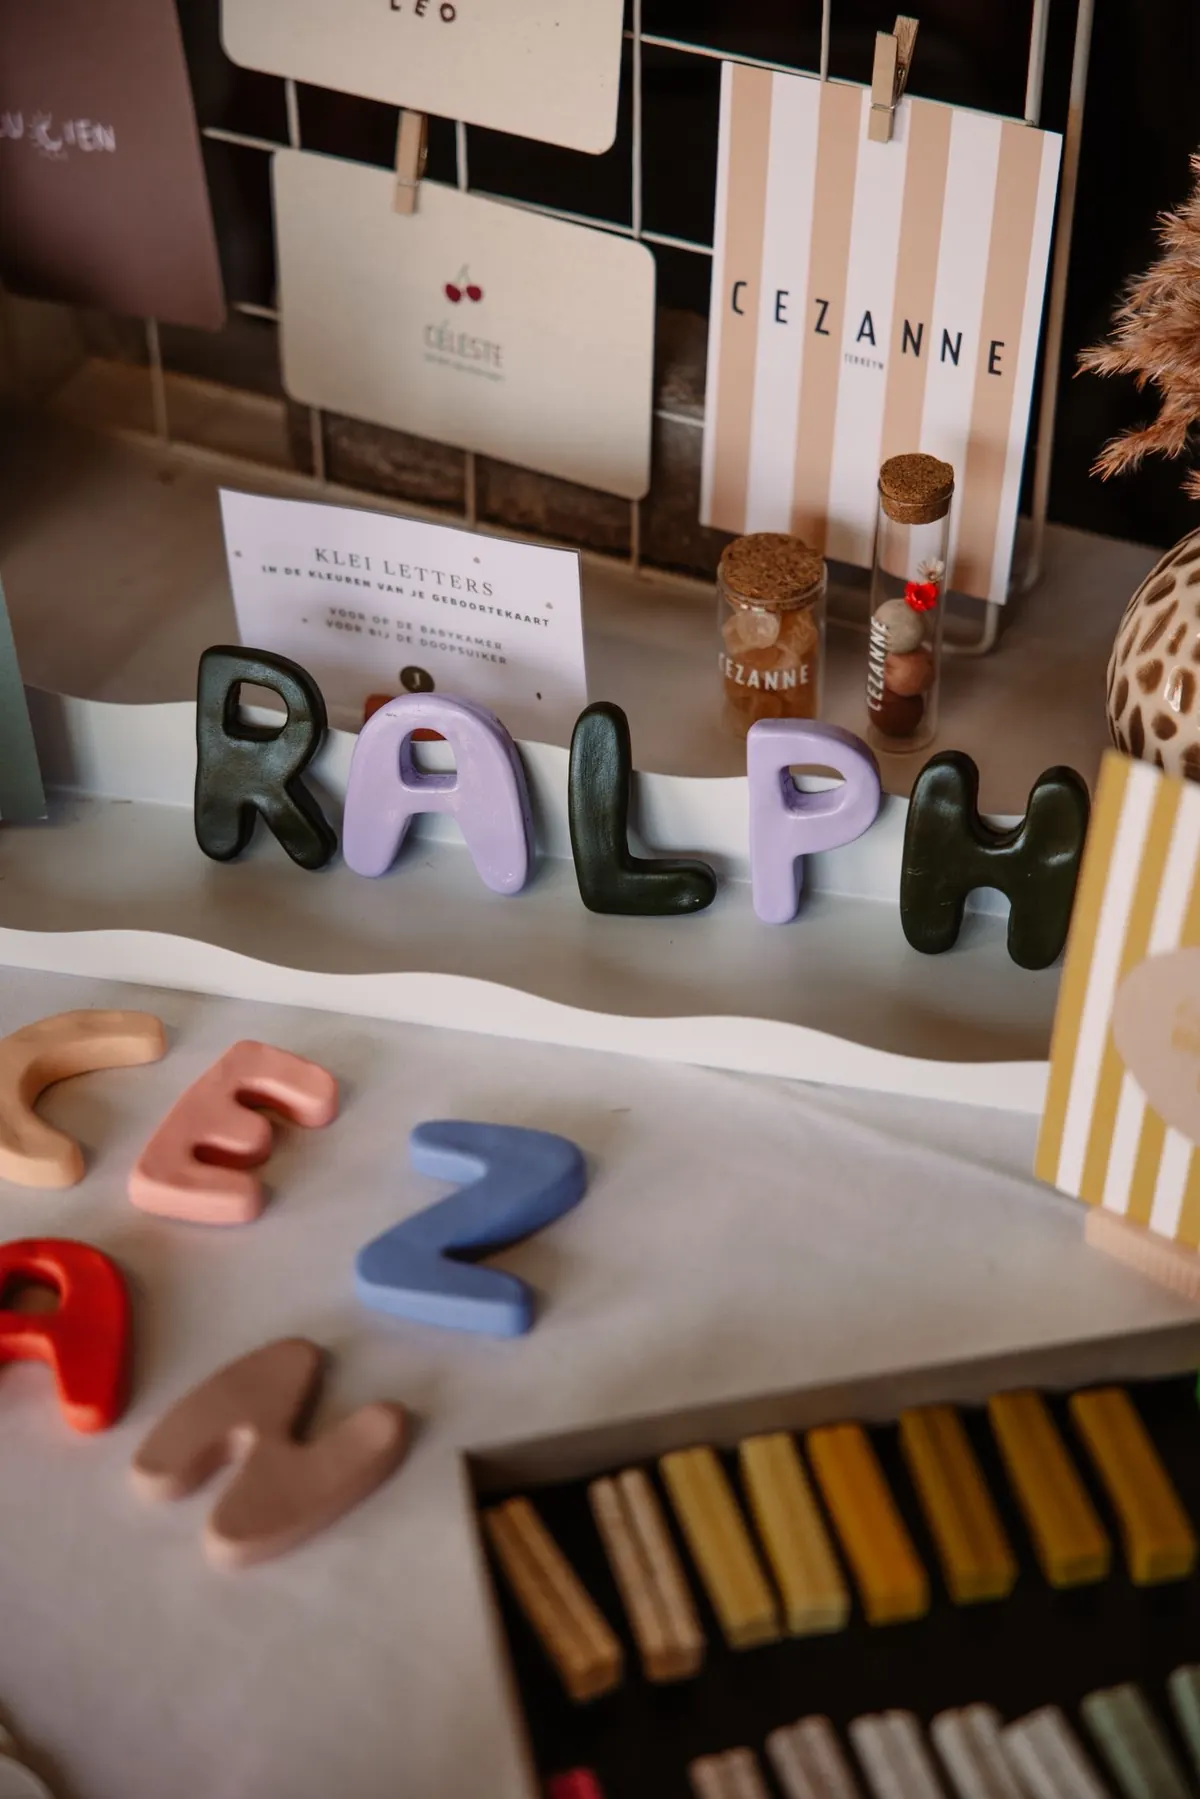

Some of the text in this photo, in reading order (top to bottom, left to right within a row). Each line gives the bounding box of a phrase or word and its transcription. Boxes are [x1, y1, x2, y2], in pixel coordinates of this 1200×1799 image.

[0, 110, 116, 158] UCIEN
[731, 280, 1005, 377] CEZANNE
[284, 567, 301, 576] DE
[308, 570, 371, 588] KLEUREN
[377, 582, 404, 594] VAN
[410, 590, 425, 600] JE
[431, 593, 550, 627] GEBOORTEKAART
[315, 547, 494, 597] KLEI LETTERS
[326, 619, 362, 633] VOOR
[396, 633, 412, 644] DE
[420, 638, 507, 665] DOOPSUIKER
[329, 607, 502, 650] VOOR OP DE BABYKAMER
[718, 651, 809, 691] CEZANNE
[866, 616, 889, 711] CEZANNE
[194, 645, 1090, 970] RALPH
